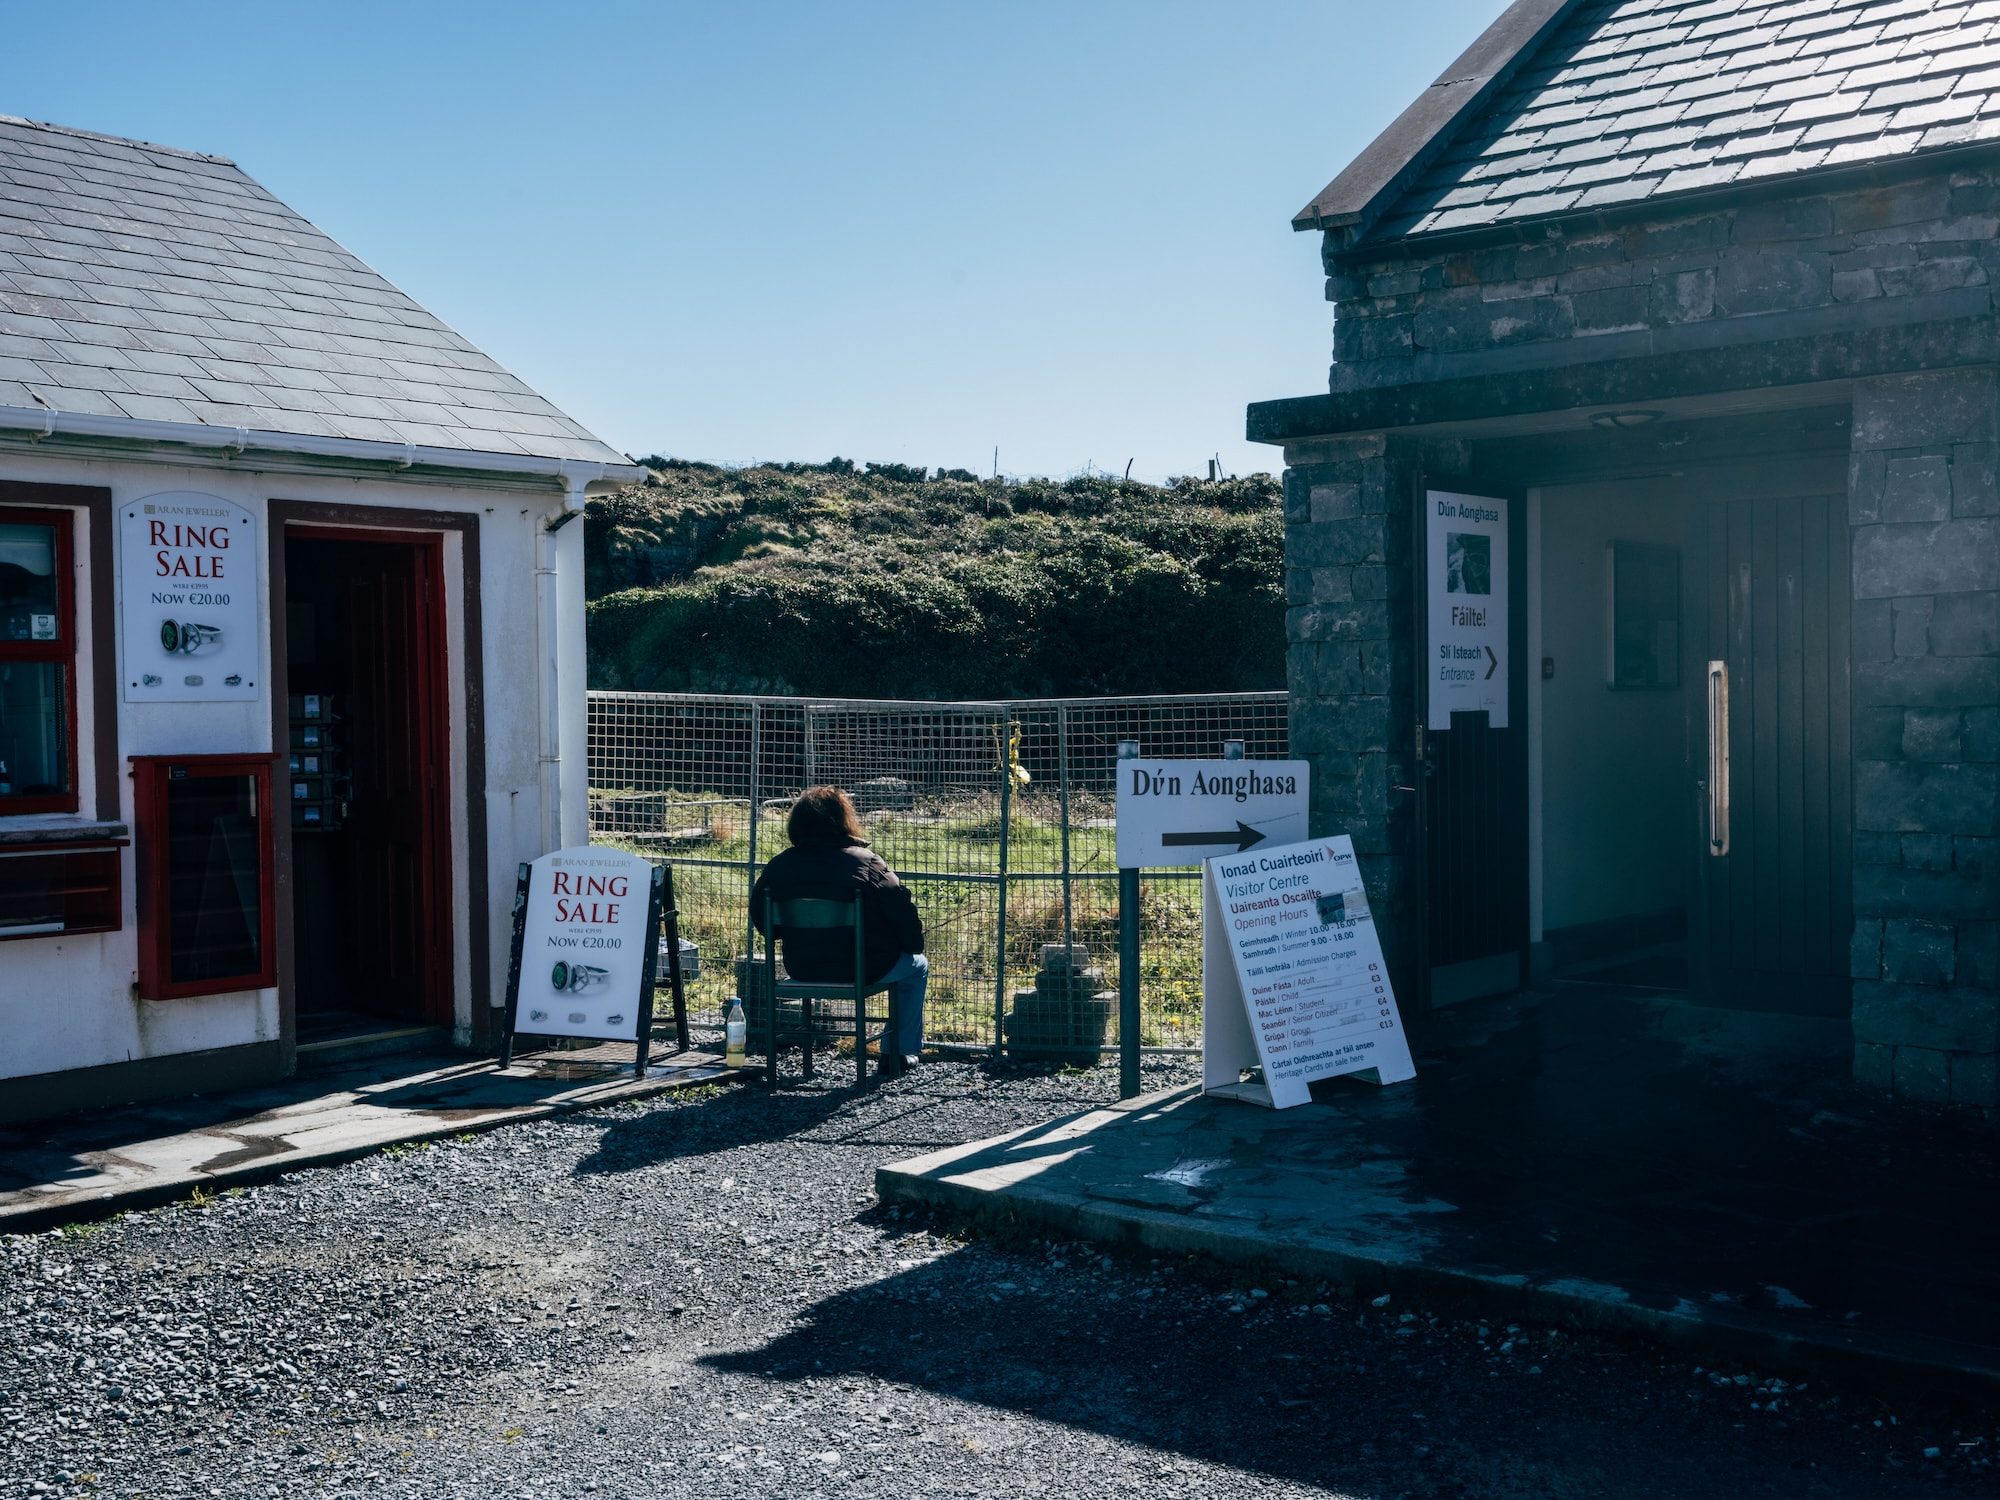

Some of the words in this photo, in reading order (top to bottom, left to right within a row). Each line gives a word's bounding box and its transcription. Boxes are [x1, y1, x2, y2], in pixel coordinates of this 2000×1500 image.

[157, 506, 184, 514] ARAN
[185, 507, 230, 517] JEWELLERY
[1438, 501, 1455, 517] Dún
[1459, 504, 1499, 523] Aonghasa
[148, 520, 230, 549] RING
[156, 551, 224, 578] SALE
[152, 593, 184, 604] NOW
[189, 593, 230, 605] €20.00
[1452, 606, 1486, 626] Fáilte!
[1441, 645, 1451, 659] Slí
[1453, 646, 1481, 659] Isteach
[1441, 667, 1475, 680] Entrance
[1132, 769, 1181, 795] Dún
[1190, 770, 1296, 803] Aonghasa
[588, 859, 632, 867] JEWELLERY
[1221, 861, 1257, 878] Ionad
[1260, 848, 1324, 871] Cuairteoirí
[552, 872, 628, 896] RING
[1226, 882, 1264, 898] Visitor
[1269, 874, 1309, 890] Centre
[555, 899, 619, 924] SALE
[1230, 897, 1279, 913] Uaireanta
[1282, 889, 1322, 904] Oscailte
[1235, 915, 1276, 931] Opening
[1280, 909, 1308, 922] Hours
[547, 936, 579, 947] NOW
[583, 937, 621, 949] €20.00
[1240, 935, 1279, 948] Geimhreadh
[1286, 930, 1307, 939] Winter
[1309, 925, 1329, 935] 10.00
[1337, 919, 1356, 929] 16.00
[1243, 947, 1276, 959] Samhradh
[1282, 941, 1309, 951] Summer
[1311, 937, 1327, 946] 9.00
[1334, 932, 1353, 941] 18.00
[1247, 968, 1263, 976] Táillí
[1266, 963, 1290, 973] Iontrála
[1297, 955, 1329, 966] Admission
[1332, 949, 1357, 960] Charges
[1252, 986, 1271, 995] Duine
[1273, 982, 1291, 991] Fásta
[1298, 976, 1315, 986] Adult
[1368, 963, 1378, 971] €5
[1255, 998, 1276, 1007] Páiste
[1282, 992, 1298, 1001] Child
[1274, 1006, 1293, 1015] Léinn
[1299, 999, 1324, 1010] Student
[1375, 986, 1384, 994] €3
[1261, 1020, 1286, 1030] Seanóir
[1293, 1014, 1312, 1023] Senior
[1315, 1009, 1338, 1019] Citizen
[1378, 997, 1387, 1005] €4
[1265, 1033, 1285, 1042] Grúpa
[1291, 1027, 1311, 1036] Group
[1268, 1045, 1287, 1053] Clann
[1293, 1039, 1314, 1048] Family
[1380, 1020, 1393, 1029] €13
[1272, 1060, 1292, 1069] Cártaí
[1294, 1051, 1333, 1064] Oidhreachta
[1344, 1044, 1354, 1053] fáil
[1356, 1042, 1374, 1050] anseo
[1275, 1068, 1303, 1079] Heritage
[1305, 1065, 1323, 1073] Cards
[1335, 1057, 1348, 1066] sale
[1350, 1054, 1364, 1062] here
